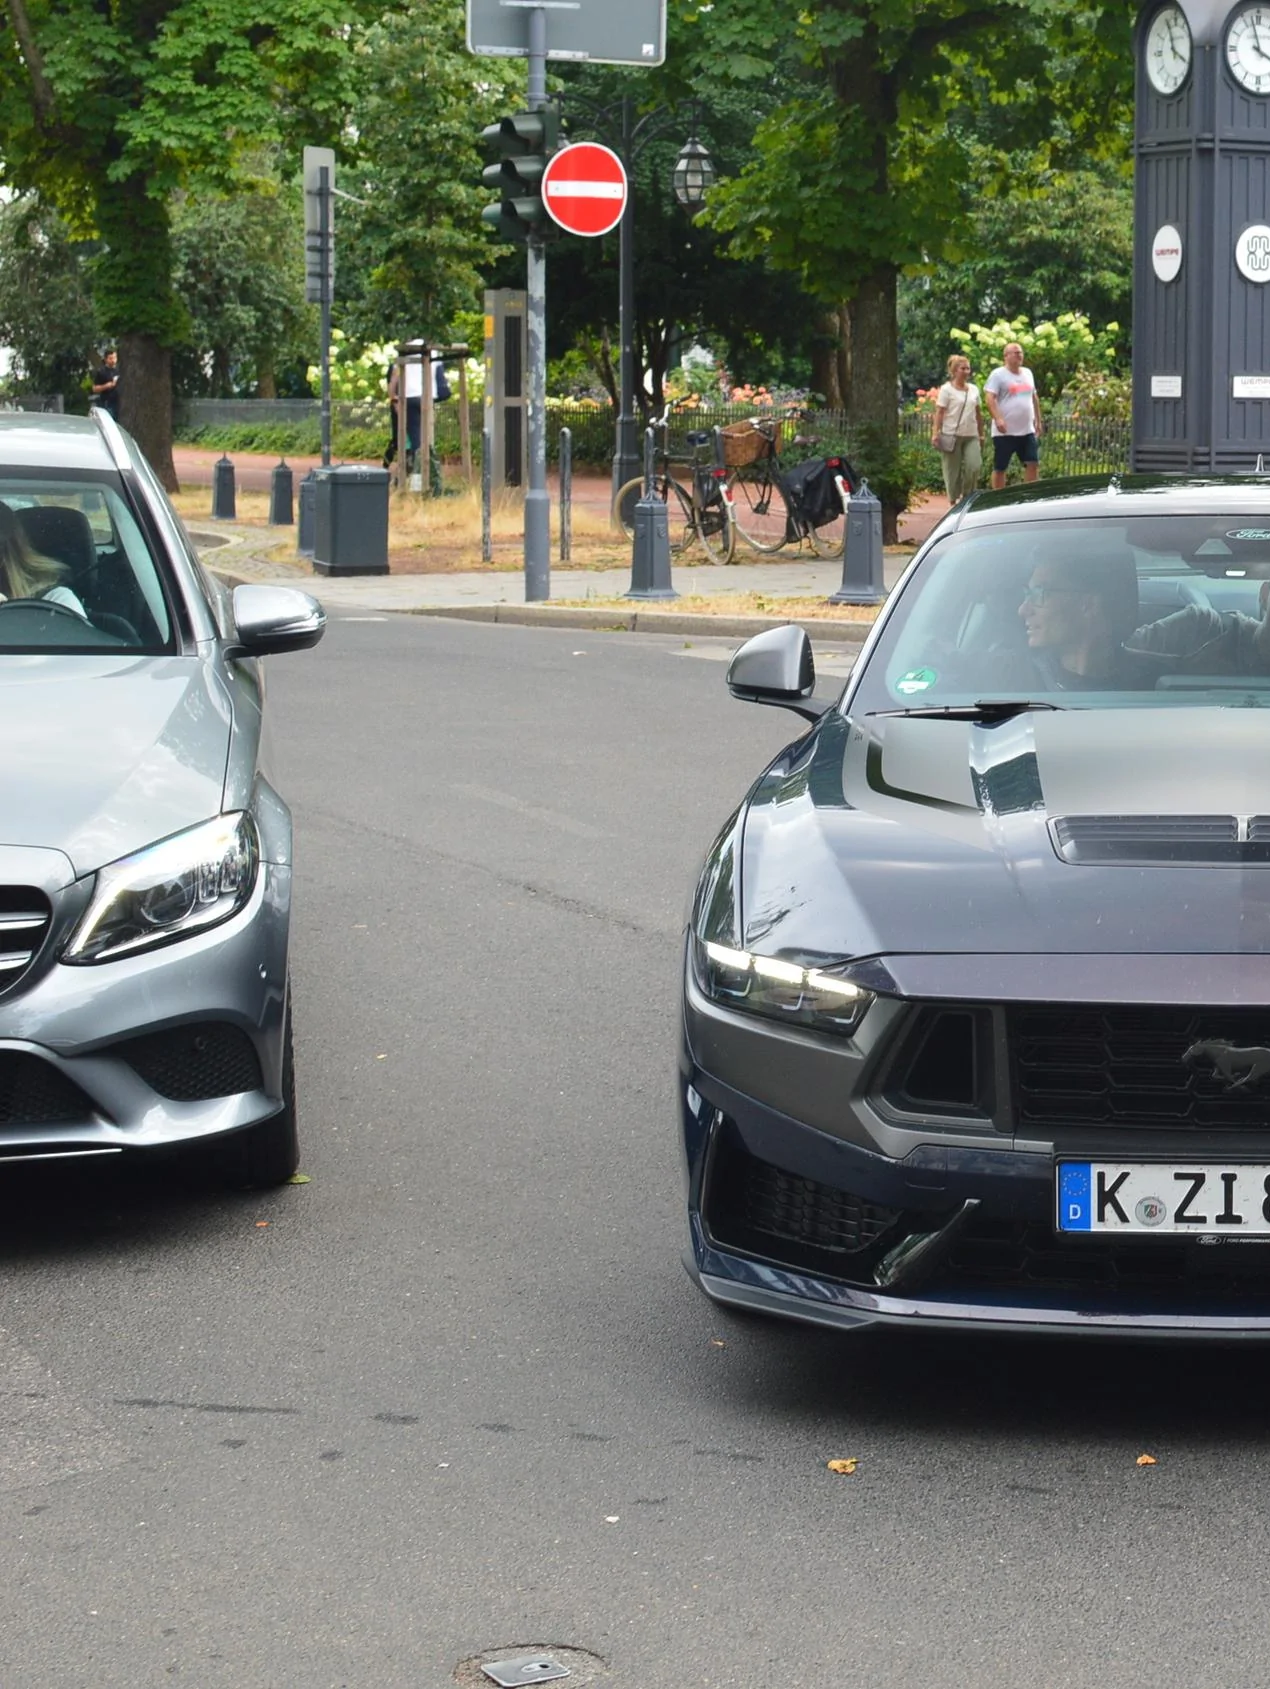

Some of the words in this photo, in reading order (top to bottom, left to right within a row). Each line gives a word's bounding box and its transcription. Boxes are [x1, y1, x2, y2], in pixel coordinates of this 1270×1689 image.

[1069, 1204, 1081, 1220] D
[1097, 1171, 1131, 1223] K
[1173, 1172, 1243, 1224] ZI
